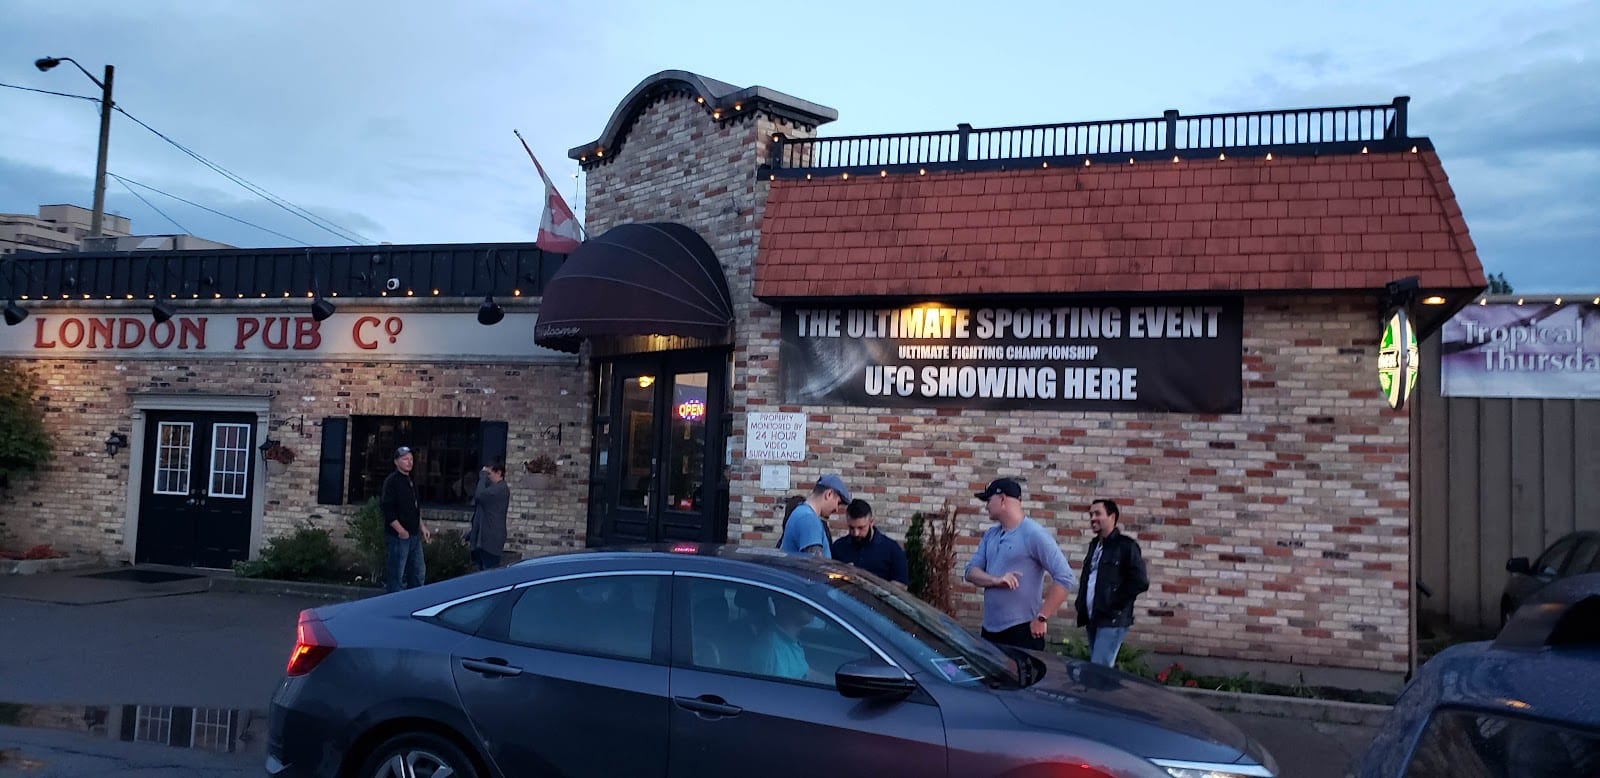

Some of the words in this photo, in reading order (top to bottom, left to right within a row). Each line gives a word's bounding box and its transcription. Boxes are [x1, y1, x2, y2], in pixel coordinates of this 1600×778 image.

[796, 307, 840, 338] THE
[847, 307, 970, 339] ULTIMATE
[976, 306, 1122, 340] SPORTING
[1129, 306, 1223, 339] EVENT
[34, 317, 208, 349] LONDON
[234, 317, 322, 350] PUB
[1461, 317, 1584, 351] Tropical
[898, 344, 950, 360] ULTIMATE
[951, 345, 1004, 360] FIGHTING
[1006, 345, 1099, 361] CHAMPIONSHIP
[864, 365, 915, 397] UFC
[920, 365, 1058, 400] SHOWING
[1063, 367, 1138, 400] HERE
[679, 403, 704, 417] OPEN
[751, 422, 791, 430] MONITORED
[793, 423, 803, 431] BY
[755, 431, 767, 440] 24
[771, 431, 797, 441] HOUR
[764, 441, 788, 450] VIDEO
